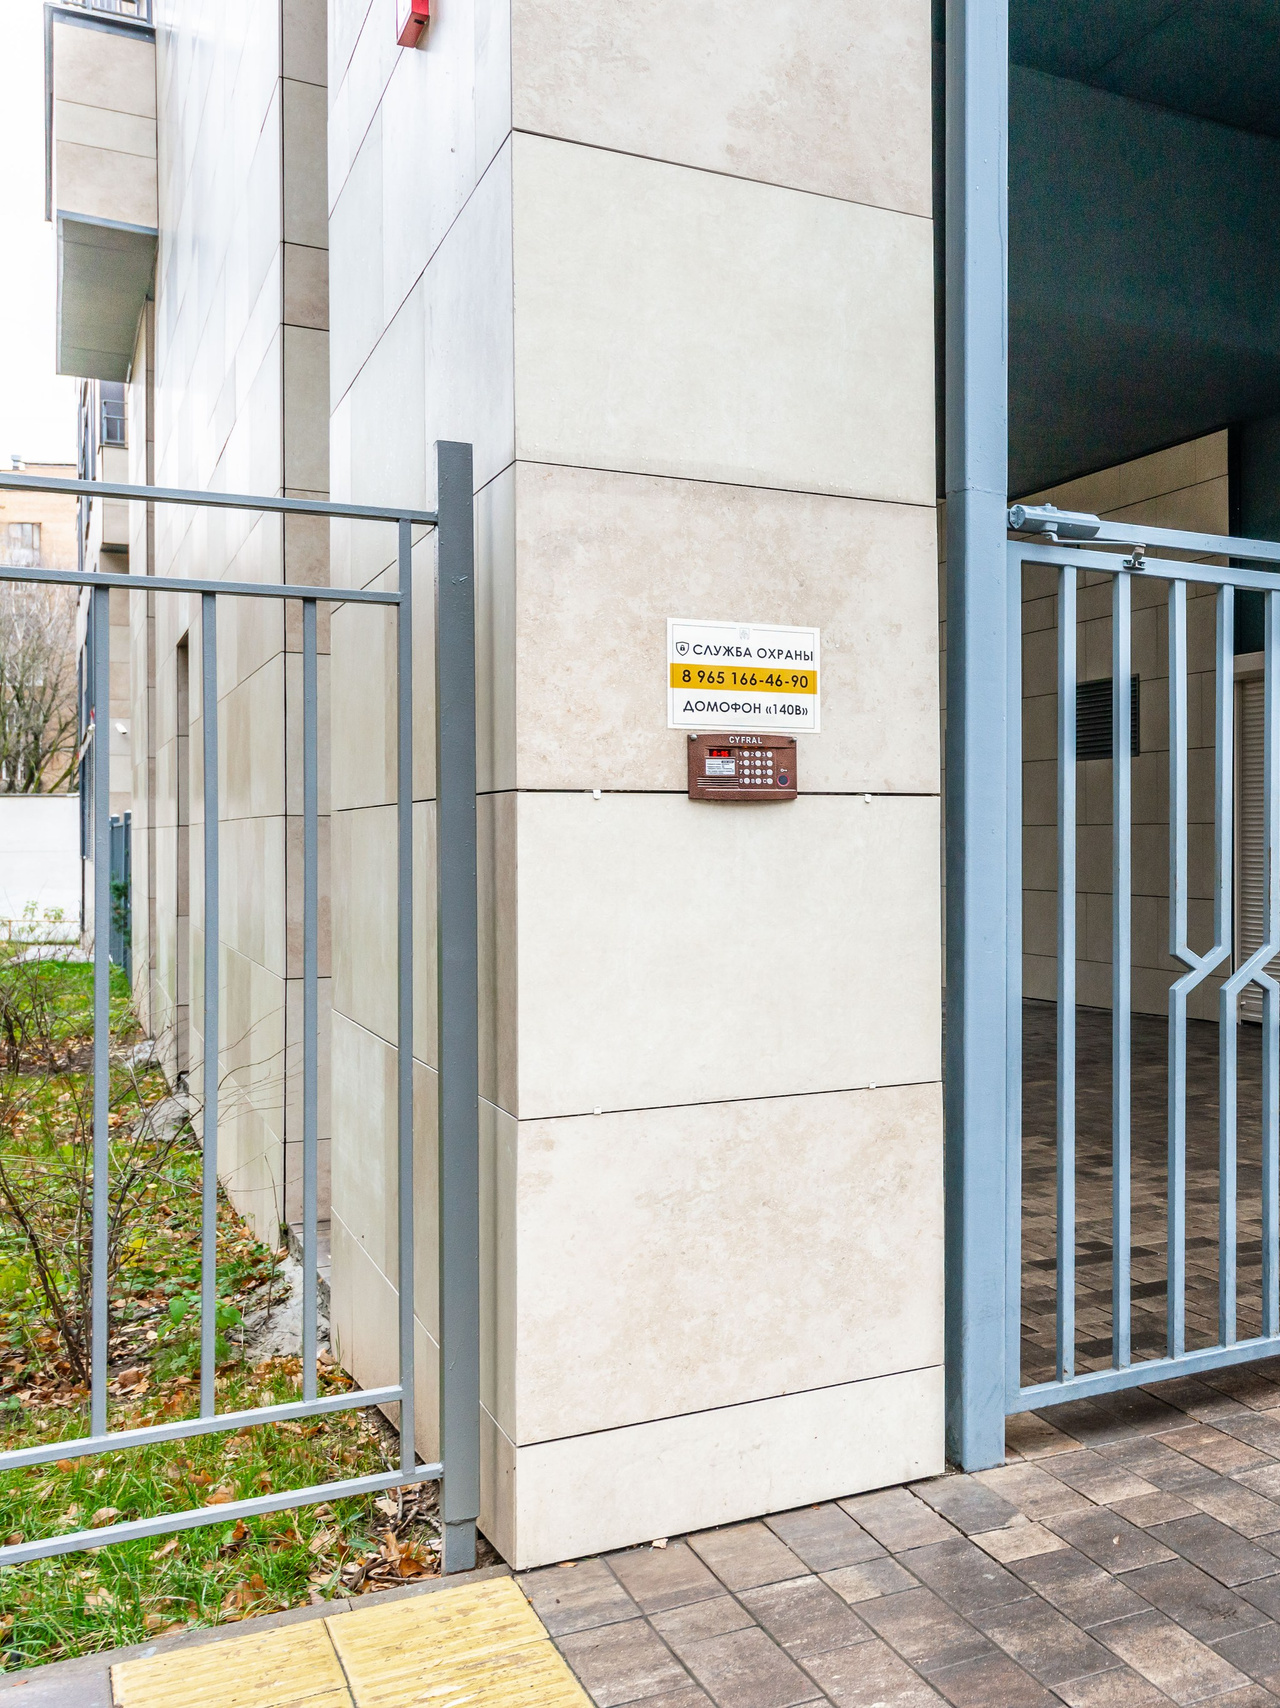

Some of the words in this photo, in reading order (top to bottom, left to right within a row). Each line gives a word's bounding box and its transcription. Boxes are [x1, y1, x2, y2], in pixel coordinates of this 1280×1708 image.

[692, 644, 752, 658] СЛУЖБА
[757, 648, 813, 661] ОХРАНЫ
[682, 669, 691, 683] 8
[697, 670, 725, 684] 965
[731, 672, 808, 688] 166-46-90
[683, 700, 761, 714] ДОМОФОН
[765, 704, 808, 716] «140В»
[729, 736, 763, 744] CYFRAL
